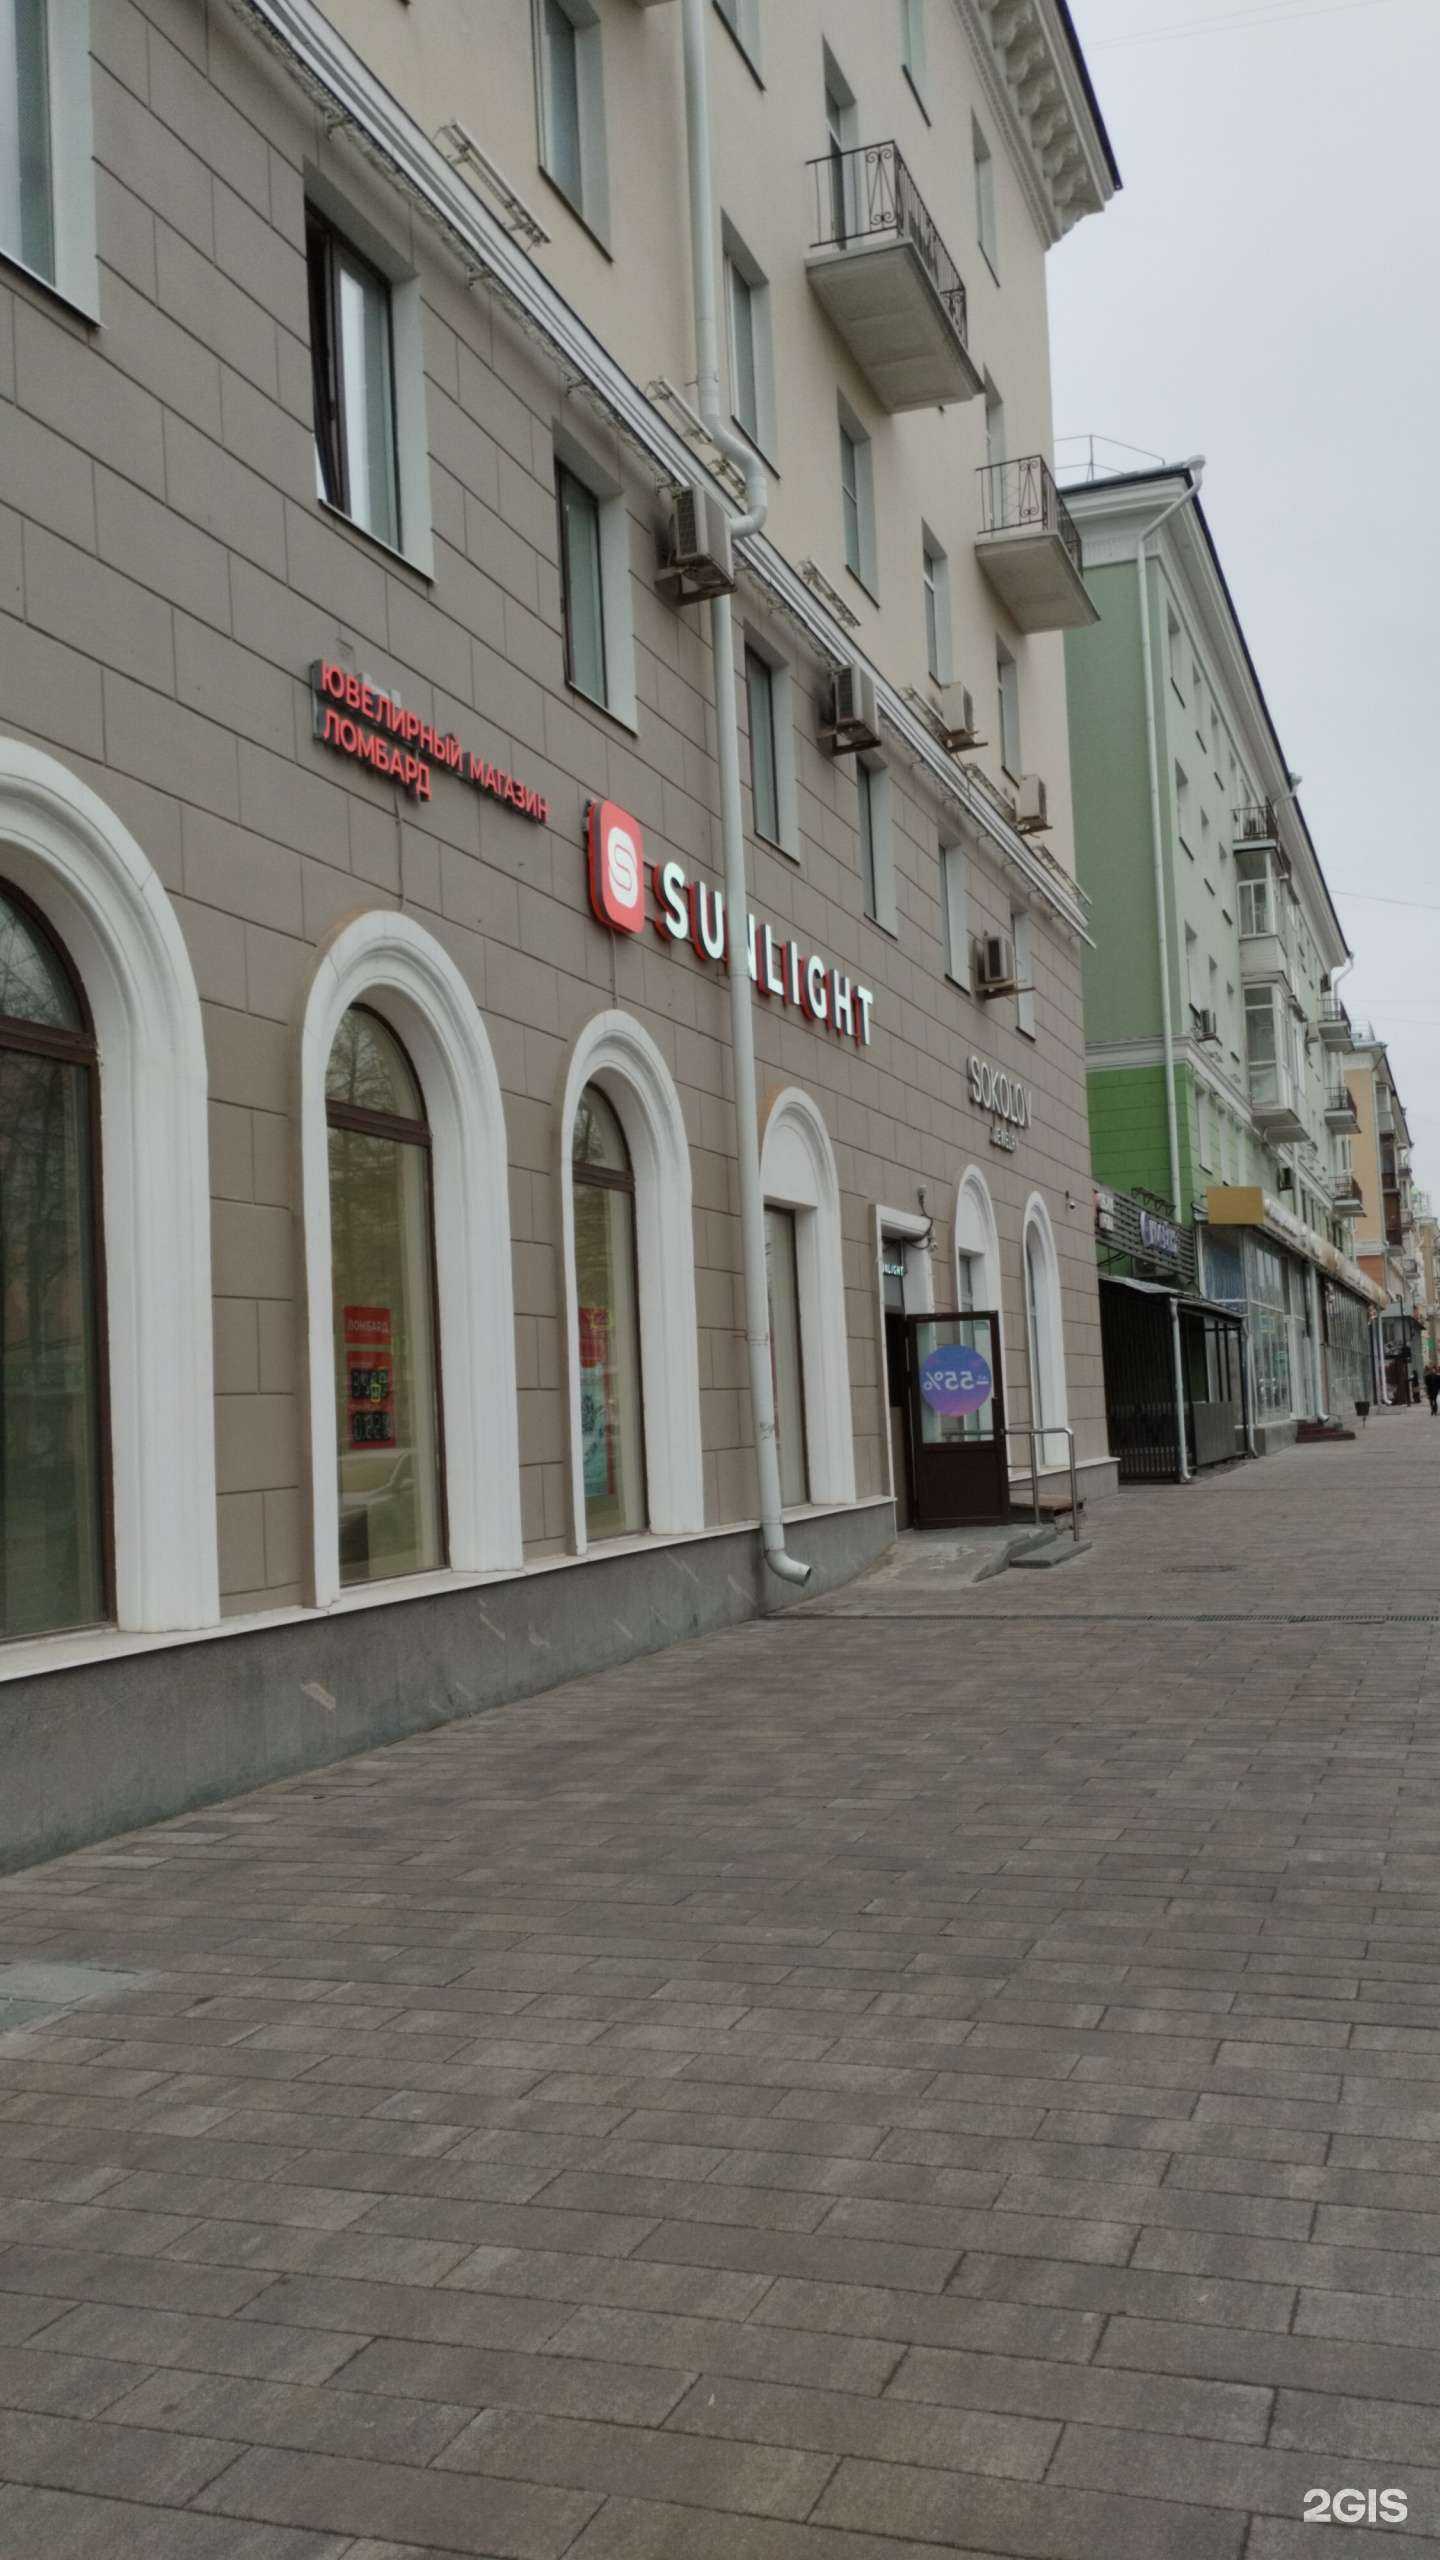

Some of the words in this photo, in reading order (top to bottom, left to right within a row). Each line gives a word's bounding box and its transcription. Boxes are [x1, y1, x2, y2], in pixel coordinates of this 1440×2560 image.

[321, 659, 464, 773] ЮВЕЛИРНЫЙ
[470, 751, 550, 823] МАГАЗИН
[323, 708, 433, 802] ЛОМБАРД
[970, 1055, 1032, 1129] SOKOLOV
